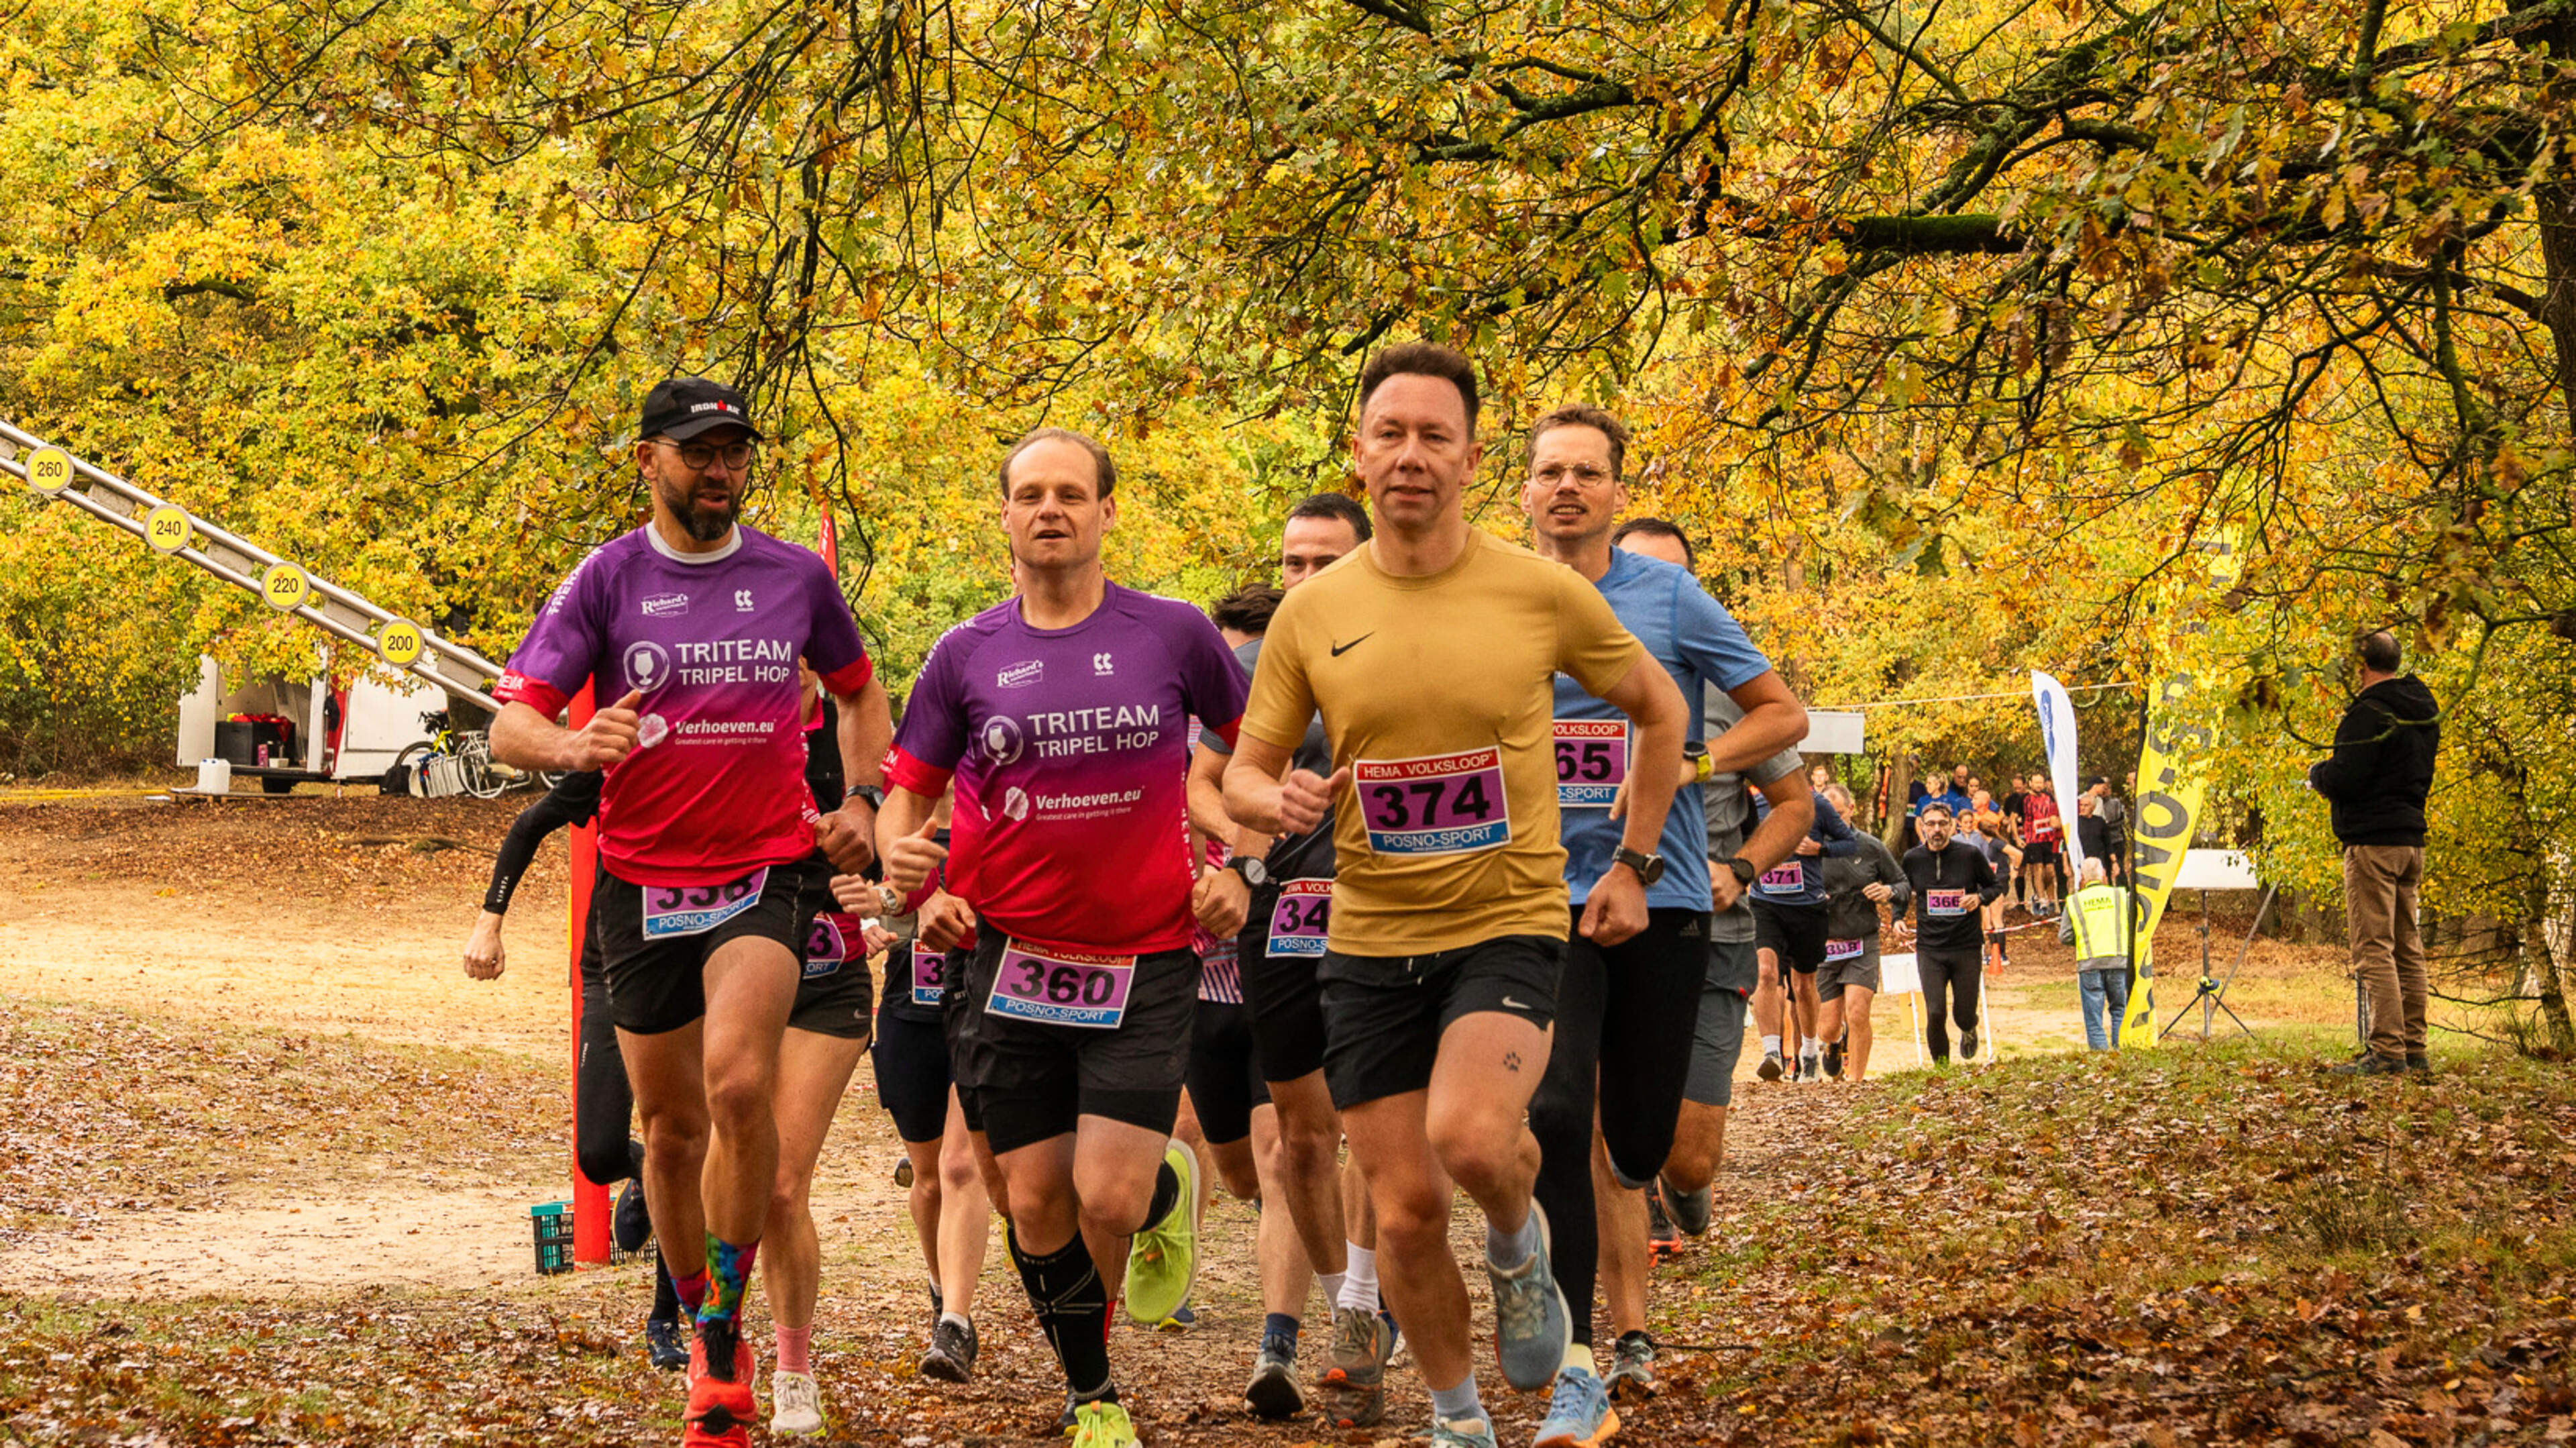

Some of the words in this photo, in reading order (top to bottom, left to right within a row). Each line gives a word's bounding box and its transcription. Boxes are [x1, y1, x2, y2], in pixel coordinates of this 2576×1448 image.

[37, 462, 62, 477] 260
[156, 519, 181, 536] 240
[273, 578, 299, 593] 220
[387, 635, 413, 651] 200
[675, 639, 792, 664] TRITEAM
[678, 666, 748, 685] TRIPEL
[755, 666, 790, 682] HOP
[676, 719, 774, 734] Verhoeven.eu
[1027, 705, 1159, 736] TRITEAM
[1552, 724, 1618, 736] OLKSLOOP
[1034, 736, 1109, 758] TRIPEL
[1116, 731, 1159, 750] HOP
[1364, 766, 1401, 778] HEMA
[1407, 754, 1489, 776] VOLKSLOOP
[1036, 789, 1142, 810] Verhoeven.eu
[1373, 776, 1490, 828] 374
[1558, 787, 1611, 799] -SPORT
[1383, 826, 1491, 847] POSNO-SPORT
[1764, 870, 1795, 884] 371
[1010, 959, 1115, 1005] 360
[1006, 999, 1107, 1021] POSNO-SPORT
